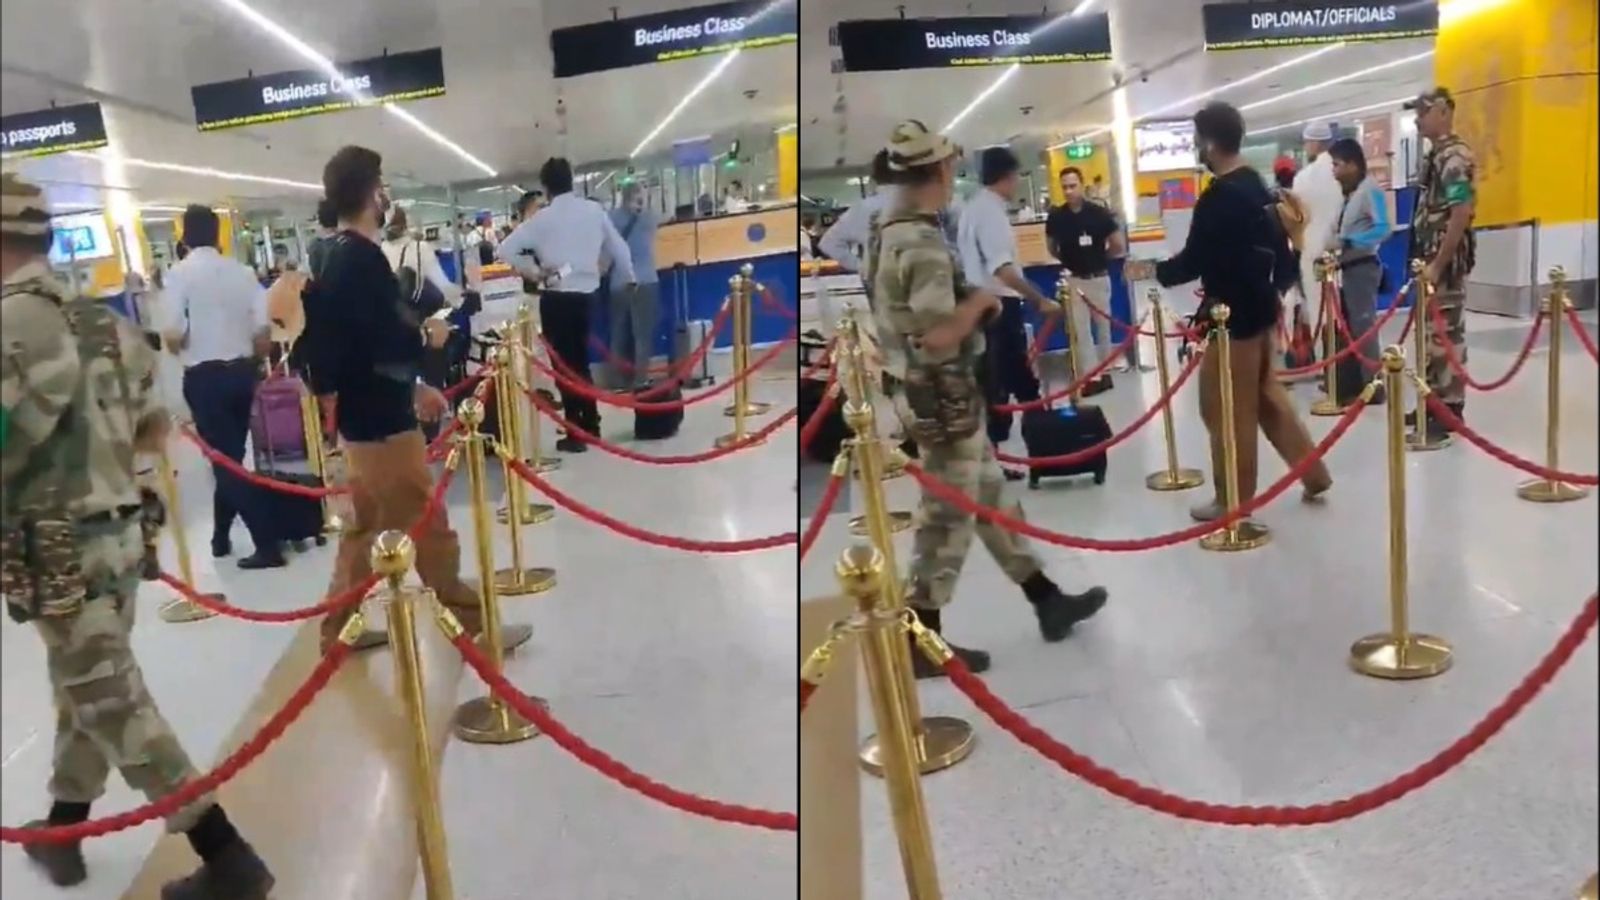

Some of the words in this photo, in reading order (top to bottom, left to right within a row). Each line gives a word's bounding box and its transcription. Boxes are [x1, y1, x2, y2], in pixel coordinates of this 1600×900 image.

[1251, 6, 1396, 29] DIPLOMAT/OFFICIALS
[634, 22, 702, 47] Business
[704, 16, 746, 36] Class
[925, 31, 990, 49] Business
[993, 28, 1031, 46] Class
[262, 81, 327, 104] Business
[9, 120, 77, 148] passports
